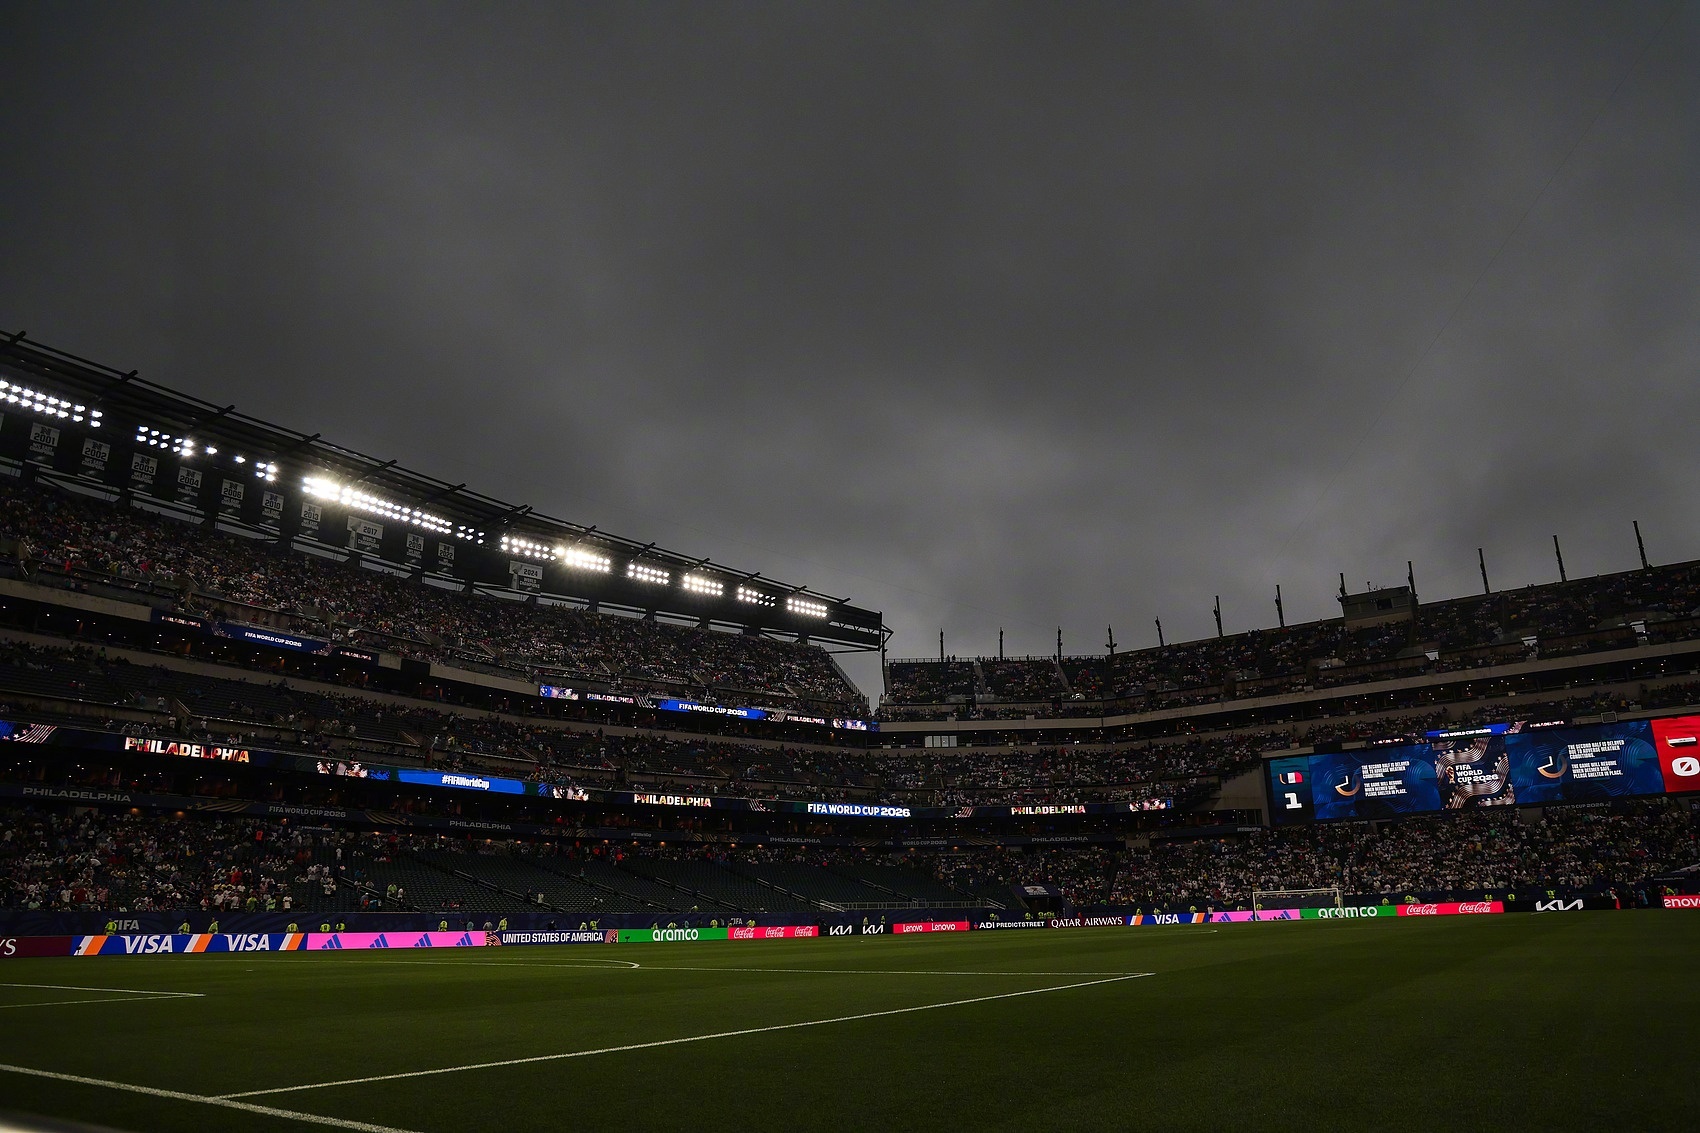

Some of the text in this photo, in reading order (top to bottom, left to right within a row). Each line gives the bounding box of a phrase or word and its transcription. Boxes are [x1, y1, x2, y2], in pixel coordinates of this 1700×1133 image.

[34, 433, 55, 445] 2001
[85, 447, 107, 460] 2002
[133, 462, 155, 474] 2003
[179, 475, 199, 487] 2004
[264, 499, 280, 510] 2010
[304, 511, 318, 520] 2013
[363, 526, 378, 536] 2017
[439, 549, 453, 560] 2022
[523, 568, 538, 577] 2024
[256, 634, 275, 642] WORLD
[586, 692, 634, 704] PHILADELPHIA
[679, 703, 693, 711] FIFA
[693, 705, 715, 713] WORLD
[727, 708, 748, 716] 2026
[786, 715, 826, 725] PHILADELPHIA
[124, 736, 250, 763] PHILADELPHIA
[1456, 769, 1483, 777] WORLD
[1672, 757, 1700, 777] 0
[442, 775, 490, 790] #FIFAWorldCup
[1457, 774, 1499, 784] CUP 2026
[22, 787, 131, 803] PHILADELPHIA
[634, 793, 712, 808] PHILADELPHIA
[1284, 792, 1302, 810] 1
[285, 807, 309, 815] WORLD
[323, 810, 347, 818] 2026
[807, 803, 911, 817] FIFA WORLD CUP 2026
[1011, 804, 1087, 815] PHILADELPHIA
[449, 820, 511, 831] PHILADELPHIA
[1031, 835, 1089, 843] PHILADELPHIA
[1664, 898, 1700, 907] enov
[1318, 906, 1377, 919] aramco
[979, 920, 995, 929] ADI
[1051, 916, 1123, 929] QATAR AIRWAYS
[1155, 913, 1180, 925] VISA
[902, 924, 924, 933] Lenovo
[931, 922, 956, 932] Lenovo
[503, 932, 604, 944] UNITED STATES OF AMERICA
[652, 928, 699, 942] aramco
[120, 935, 173, 954] VISA
[223, 934, 270, 952] VISA
